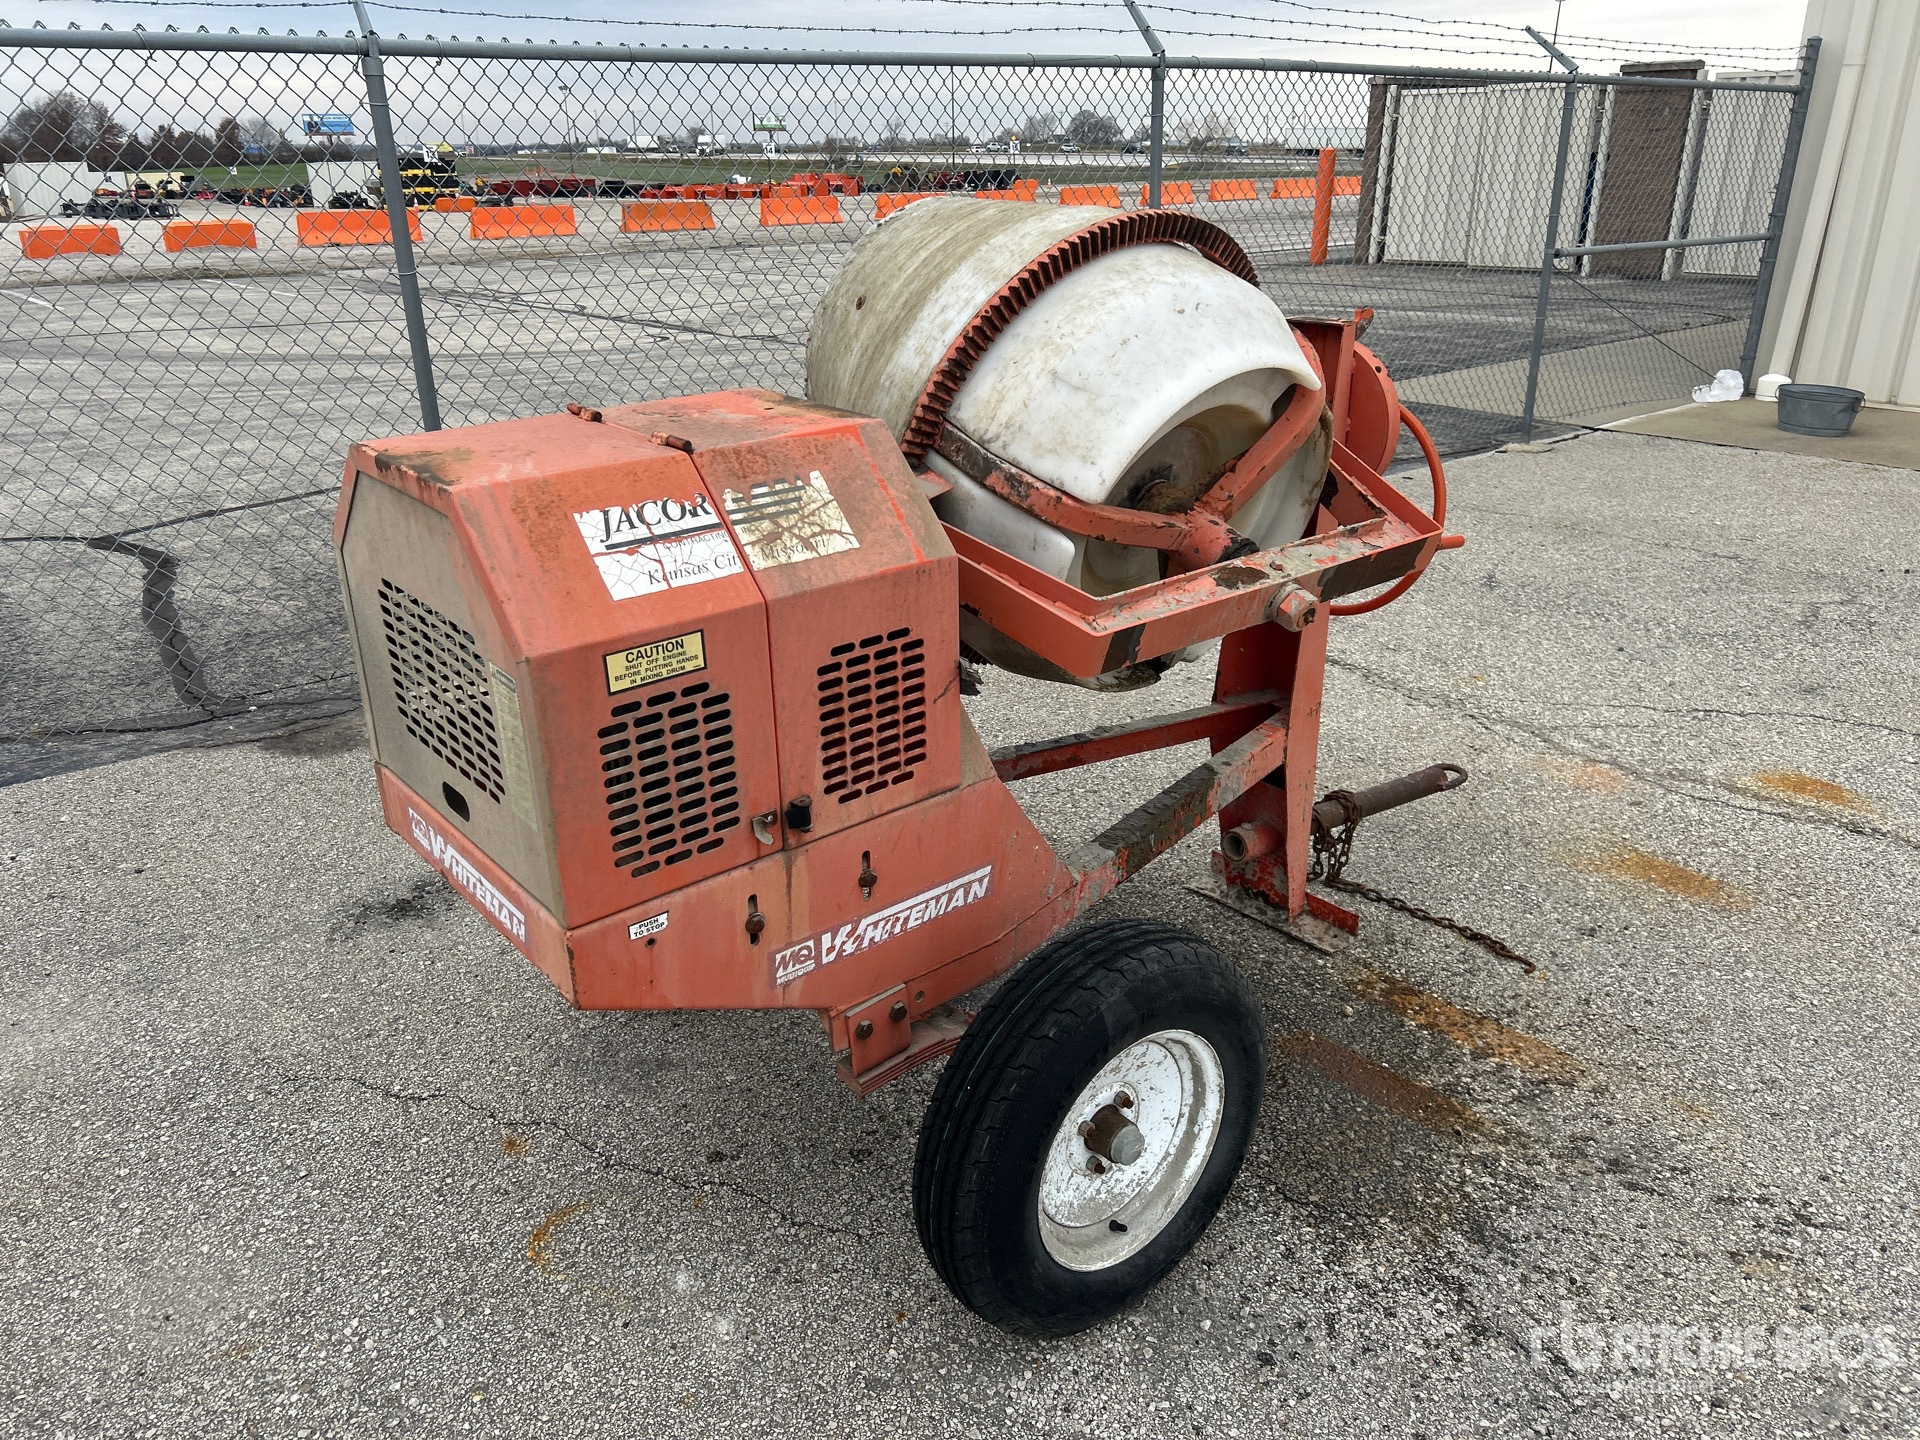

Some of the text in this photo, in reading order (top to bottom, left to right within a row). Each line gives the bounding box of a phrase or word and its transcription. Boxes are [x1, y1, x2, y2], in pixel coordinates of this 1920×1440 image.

[600, 492, 713, 543] JACOR
[761, 537, 826, 561] Missori
[625, 638, 685, 664] CAUTION
[625, 650, 687, 671] SHUT OFF ENGINE
[614, 654, 699, 682] BEFORE PUTTING HANDS
[640, 671, 663, 683] MIXING
[666, 665, 686, 675] DRUM
[429, 826, 526, 942] WHITEMAN
[638, 918, 660, 930] PUSH
[645, 921, 665, 932] STOP
[822, 865, 992, 964] WHITEMAN
